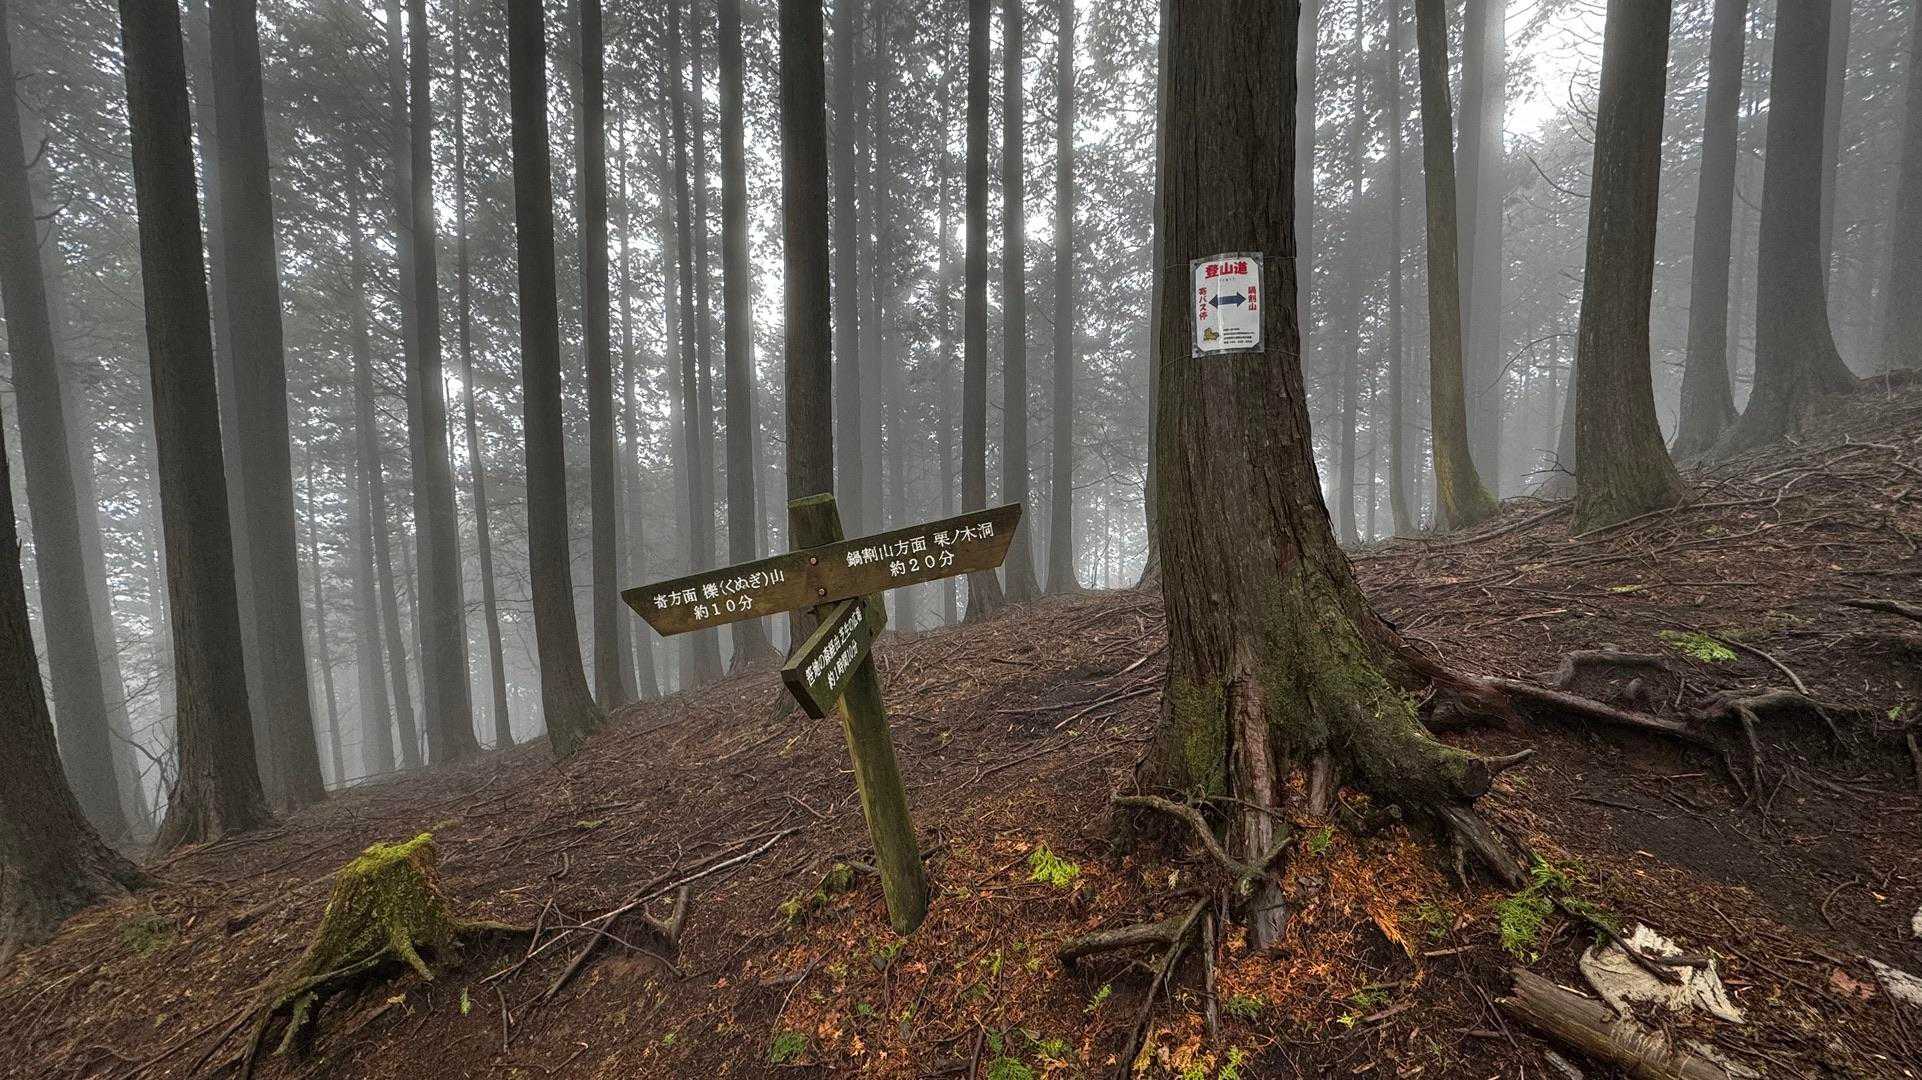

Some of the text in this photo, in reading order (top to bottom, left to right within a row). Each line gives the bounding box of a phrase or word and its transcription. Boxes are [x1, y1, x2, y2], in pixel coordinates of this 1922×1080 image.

[1205, 261, 1248, 279] 登山道
[846, 521, 994, 568] 鍋割山方面 栗ノ木洞
